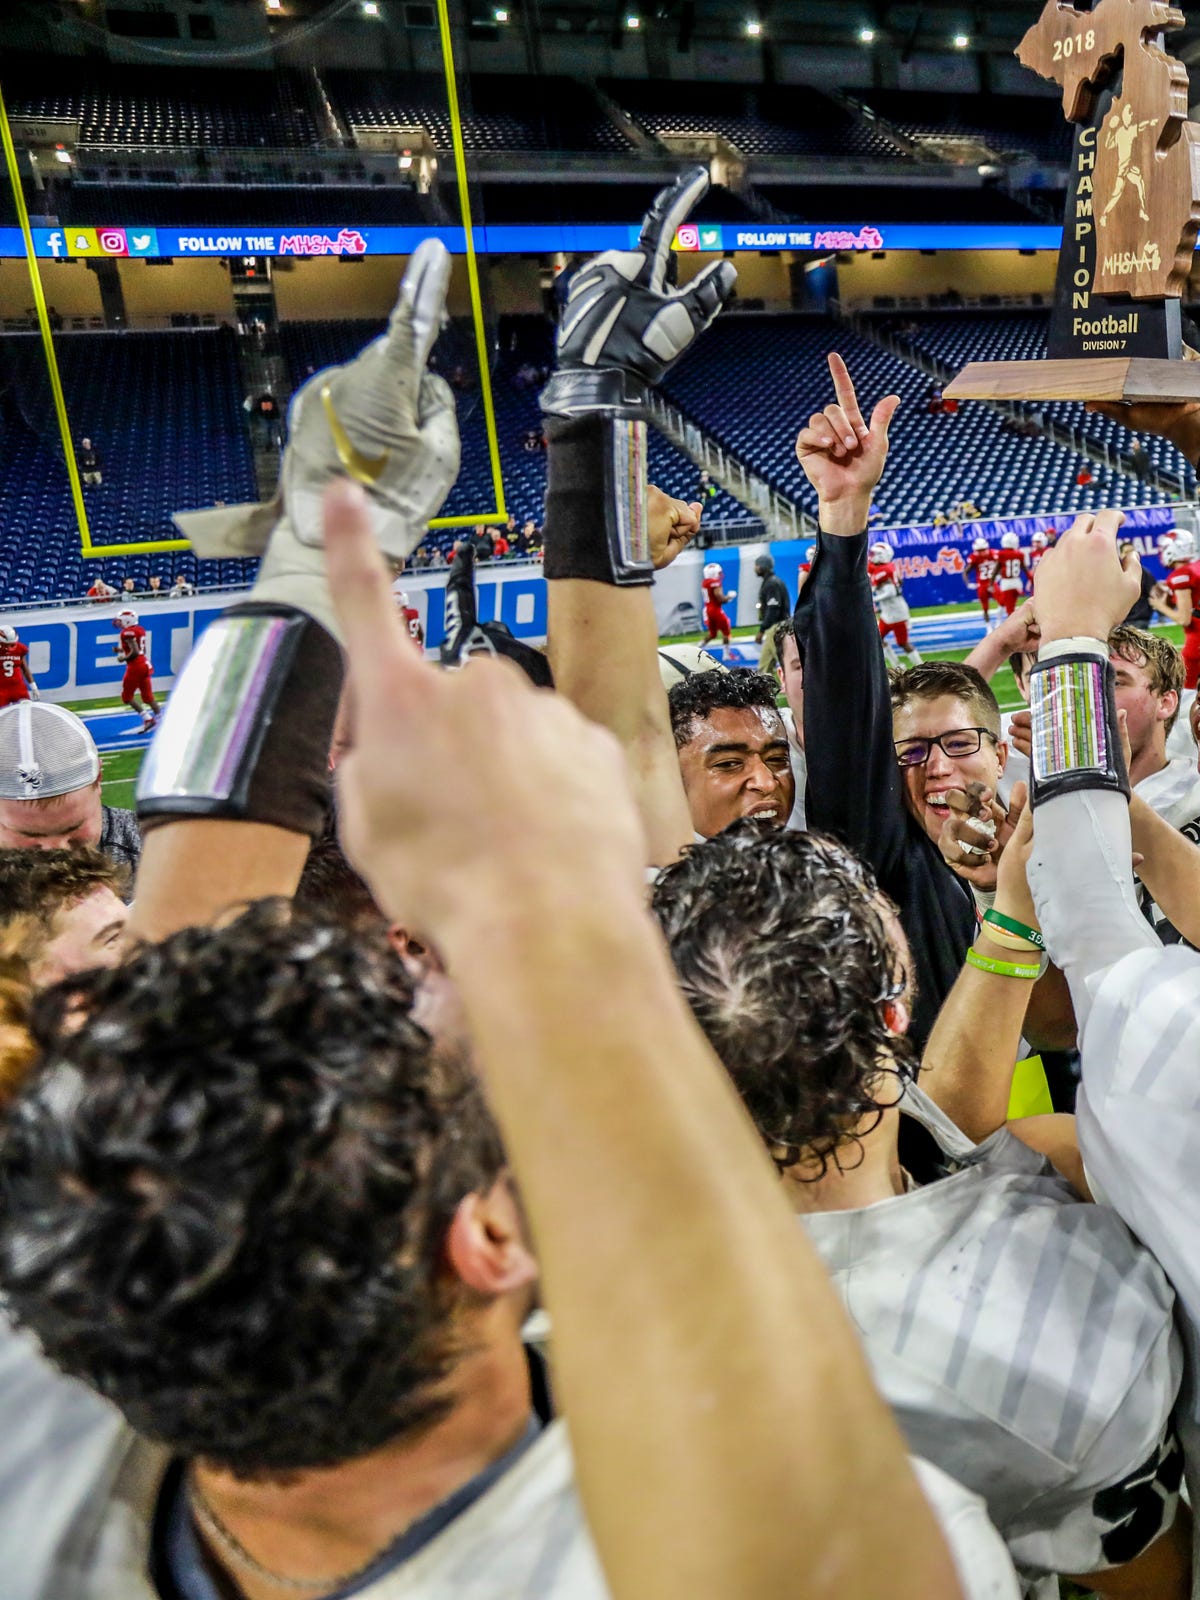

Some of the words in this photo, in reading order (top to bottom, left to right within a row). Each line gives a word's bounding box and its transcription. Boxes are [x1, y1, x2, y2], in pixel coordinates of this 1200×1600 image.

[1053, 30, 1095, 62] 2018
[1072, 126, 1096, 310] CHAMPION
[179, 236, 242, 251] FOLLOW
[244, 237, 275, 251] THE
[737, 232, 786, 246] FOLLOW
[789, 233, 811, 245] THE
[1102, 250, 1152, 276] MHSAA
[1073, 314, 1138, 337] Football
[1082, 340, 1119, 351] DIVISION
[1121, 339, 1126, 349] 7
[1005, 559, 1021, 578] 18
[2, 660, 15, 677] 9
